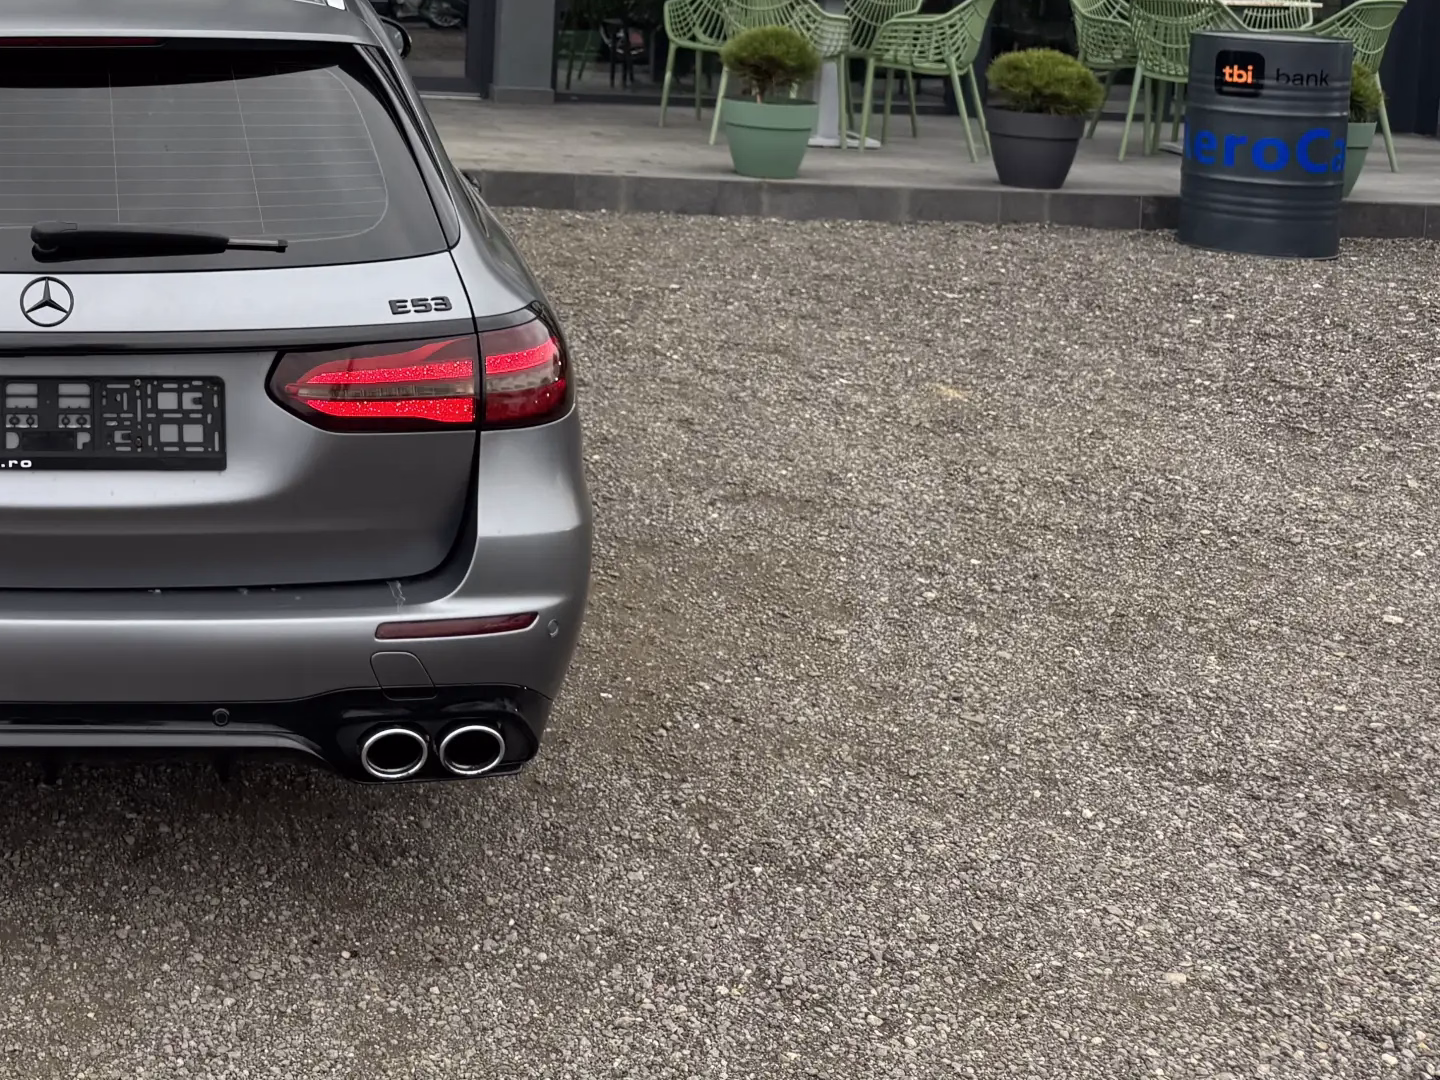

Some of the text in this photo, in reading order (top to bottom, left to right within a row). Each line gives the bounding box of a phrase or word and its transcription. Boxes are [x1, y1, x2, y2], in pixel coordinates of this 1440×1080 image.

[1222, 65, 1329, 87] tbi bank
[388, 295, 453, 315] E53
